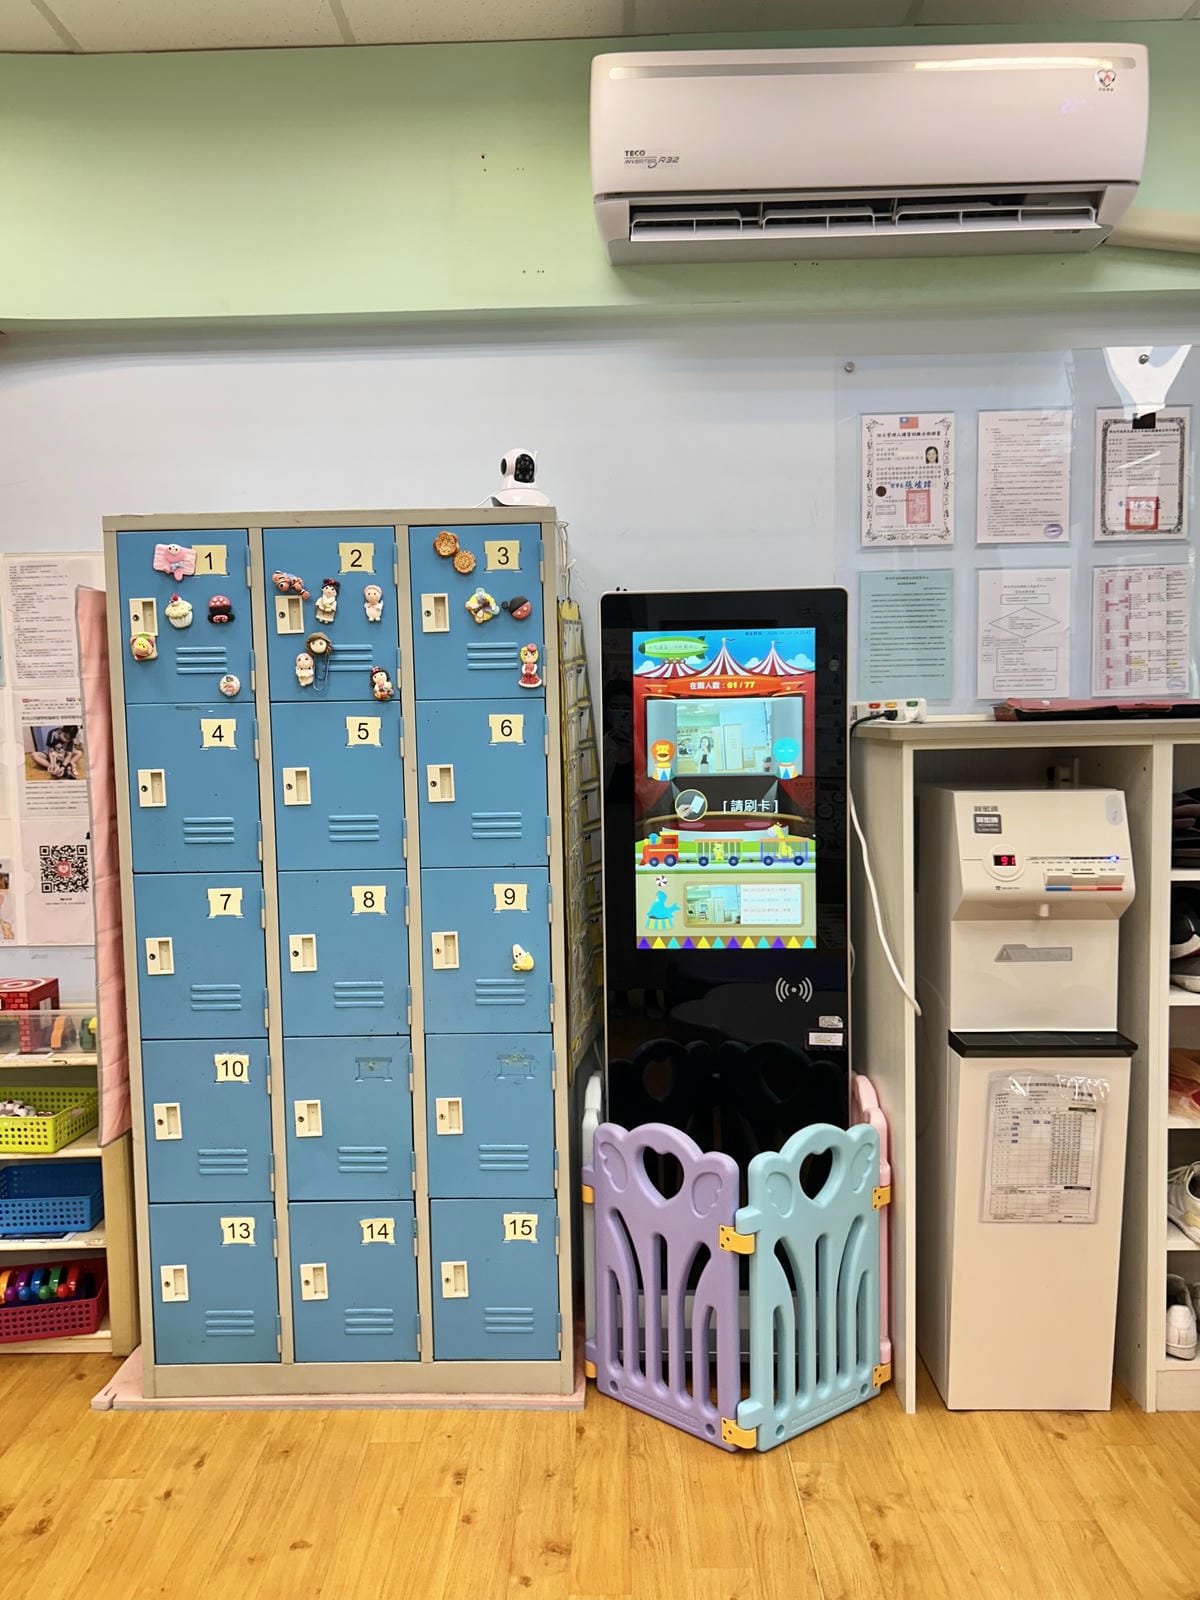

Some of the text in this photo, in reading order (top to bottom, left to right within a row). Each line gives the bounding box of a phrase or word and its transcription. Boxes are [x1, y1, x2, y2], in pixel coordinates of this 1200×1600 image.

[658, 156, 680, 164] R32
[204, 552, 213, 571] 1
[350, 549, 363, 568] 2
[497, 547, 510, 566] 3
[744, 681, 756, 689] 77
[211, 724, 225, 743] 4
[356, 722, 370, 741] 5
[500, 719, 513, 737] 6
[219, 893, 232, 911] 7
[362, 890, 375, 909] 8
[503, 887, 516, 906] 9
[222, 1060, 244, 1078] 10
[228, 1222, 251, 1240] 13
[367, 1223, 389, 1240] 14
[510, 1219, 533, 1236] 15
